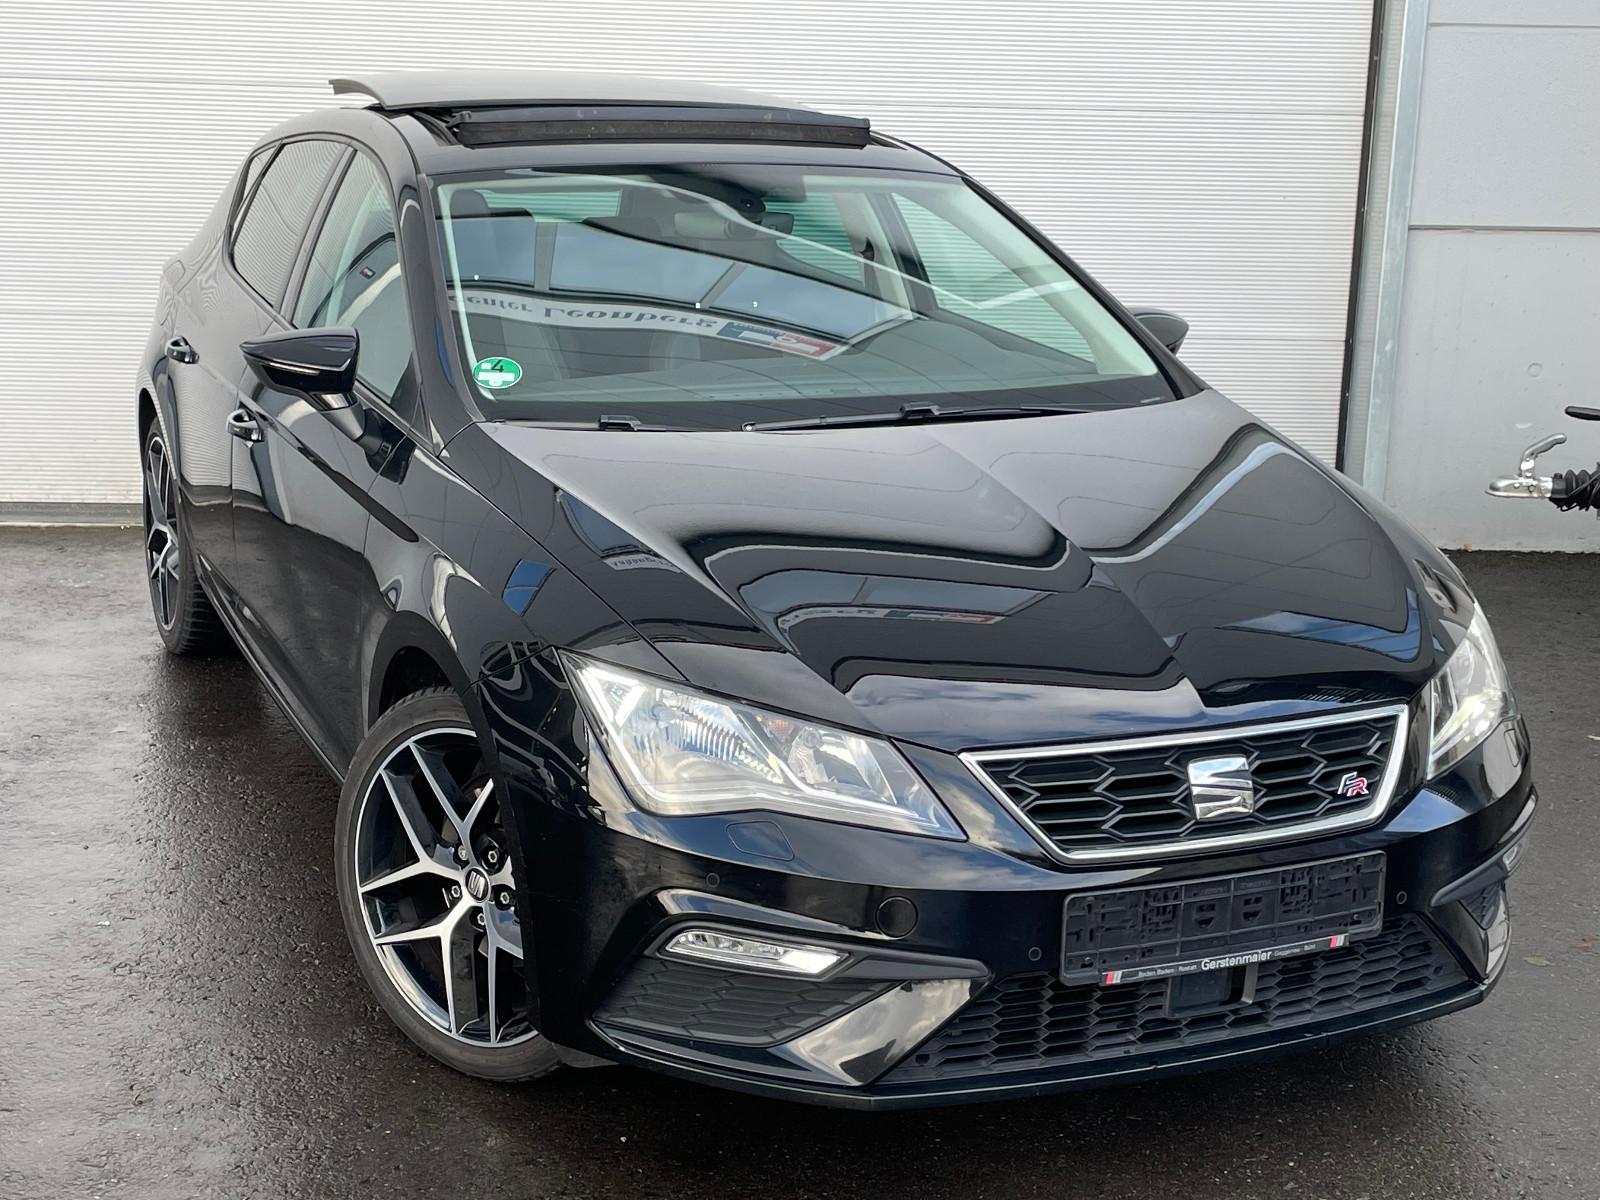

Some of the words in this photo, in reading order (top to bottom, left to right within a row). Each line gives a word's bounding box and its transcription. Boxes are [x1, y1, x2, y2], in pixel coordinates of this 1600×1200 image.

[491, 359, 504, 373] 4
[1337, 771, 1370, 797] FR
[1201, 951, 1272, 971] Gerstenmaier
